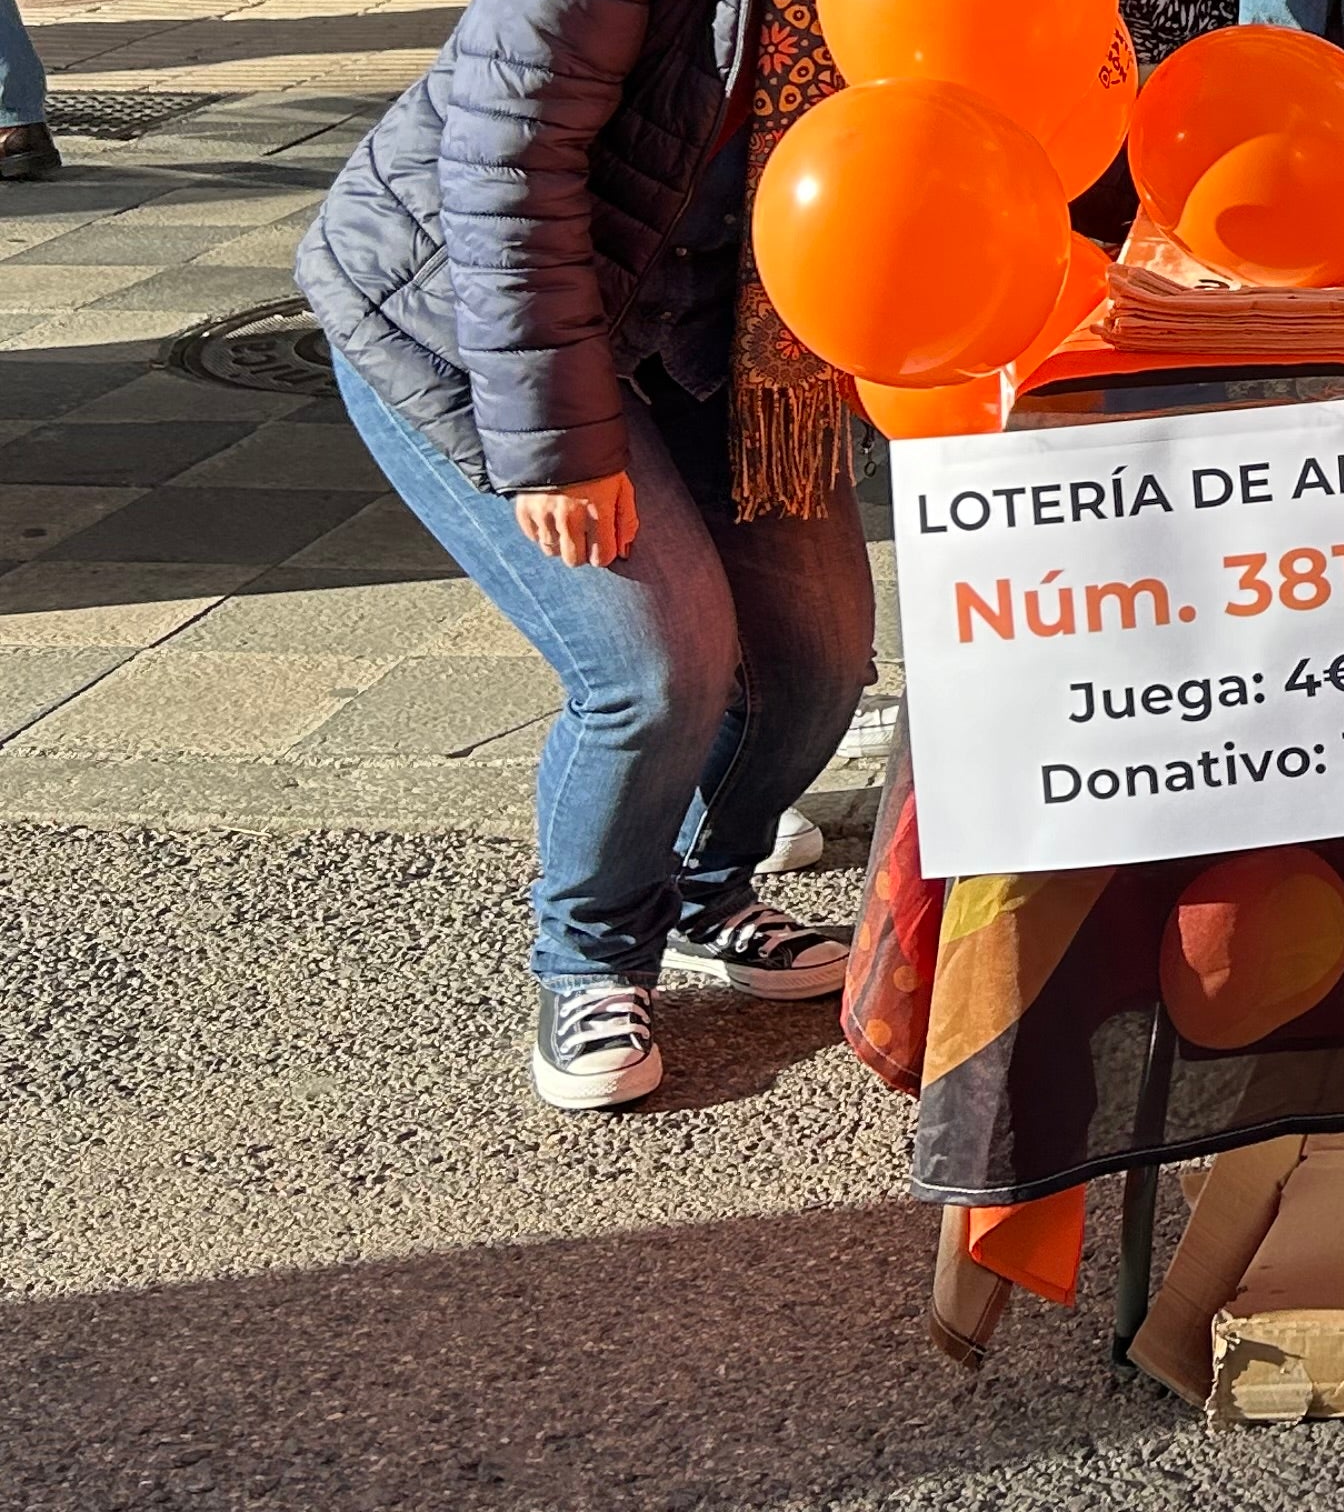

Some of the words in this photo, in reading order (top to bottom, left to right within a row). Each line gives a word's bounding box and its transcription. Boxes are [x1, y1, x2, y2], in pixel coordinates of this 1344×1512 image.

[919, 464, 1173, 534] LOTERÍA
[1193, 461, 1273, 510] DE
[953, 568, 1196, 644] Núm.
[1068, 668, 1265, 725] Juega:
[1041, 741, 1325, 805] Donativo:
